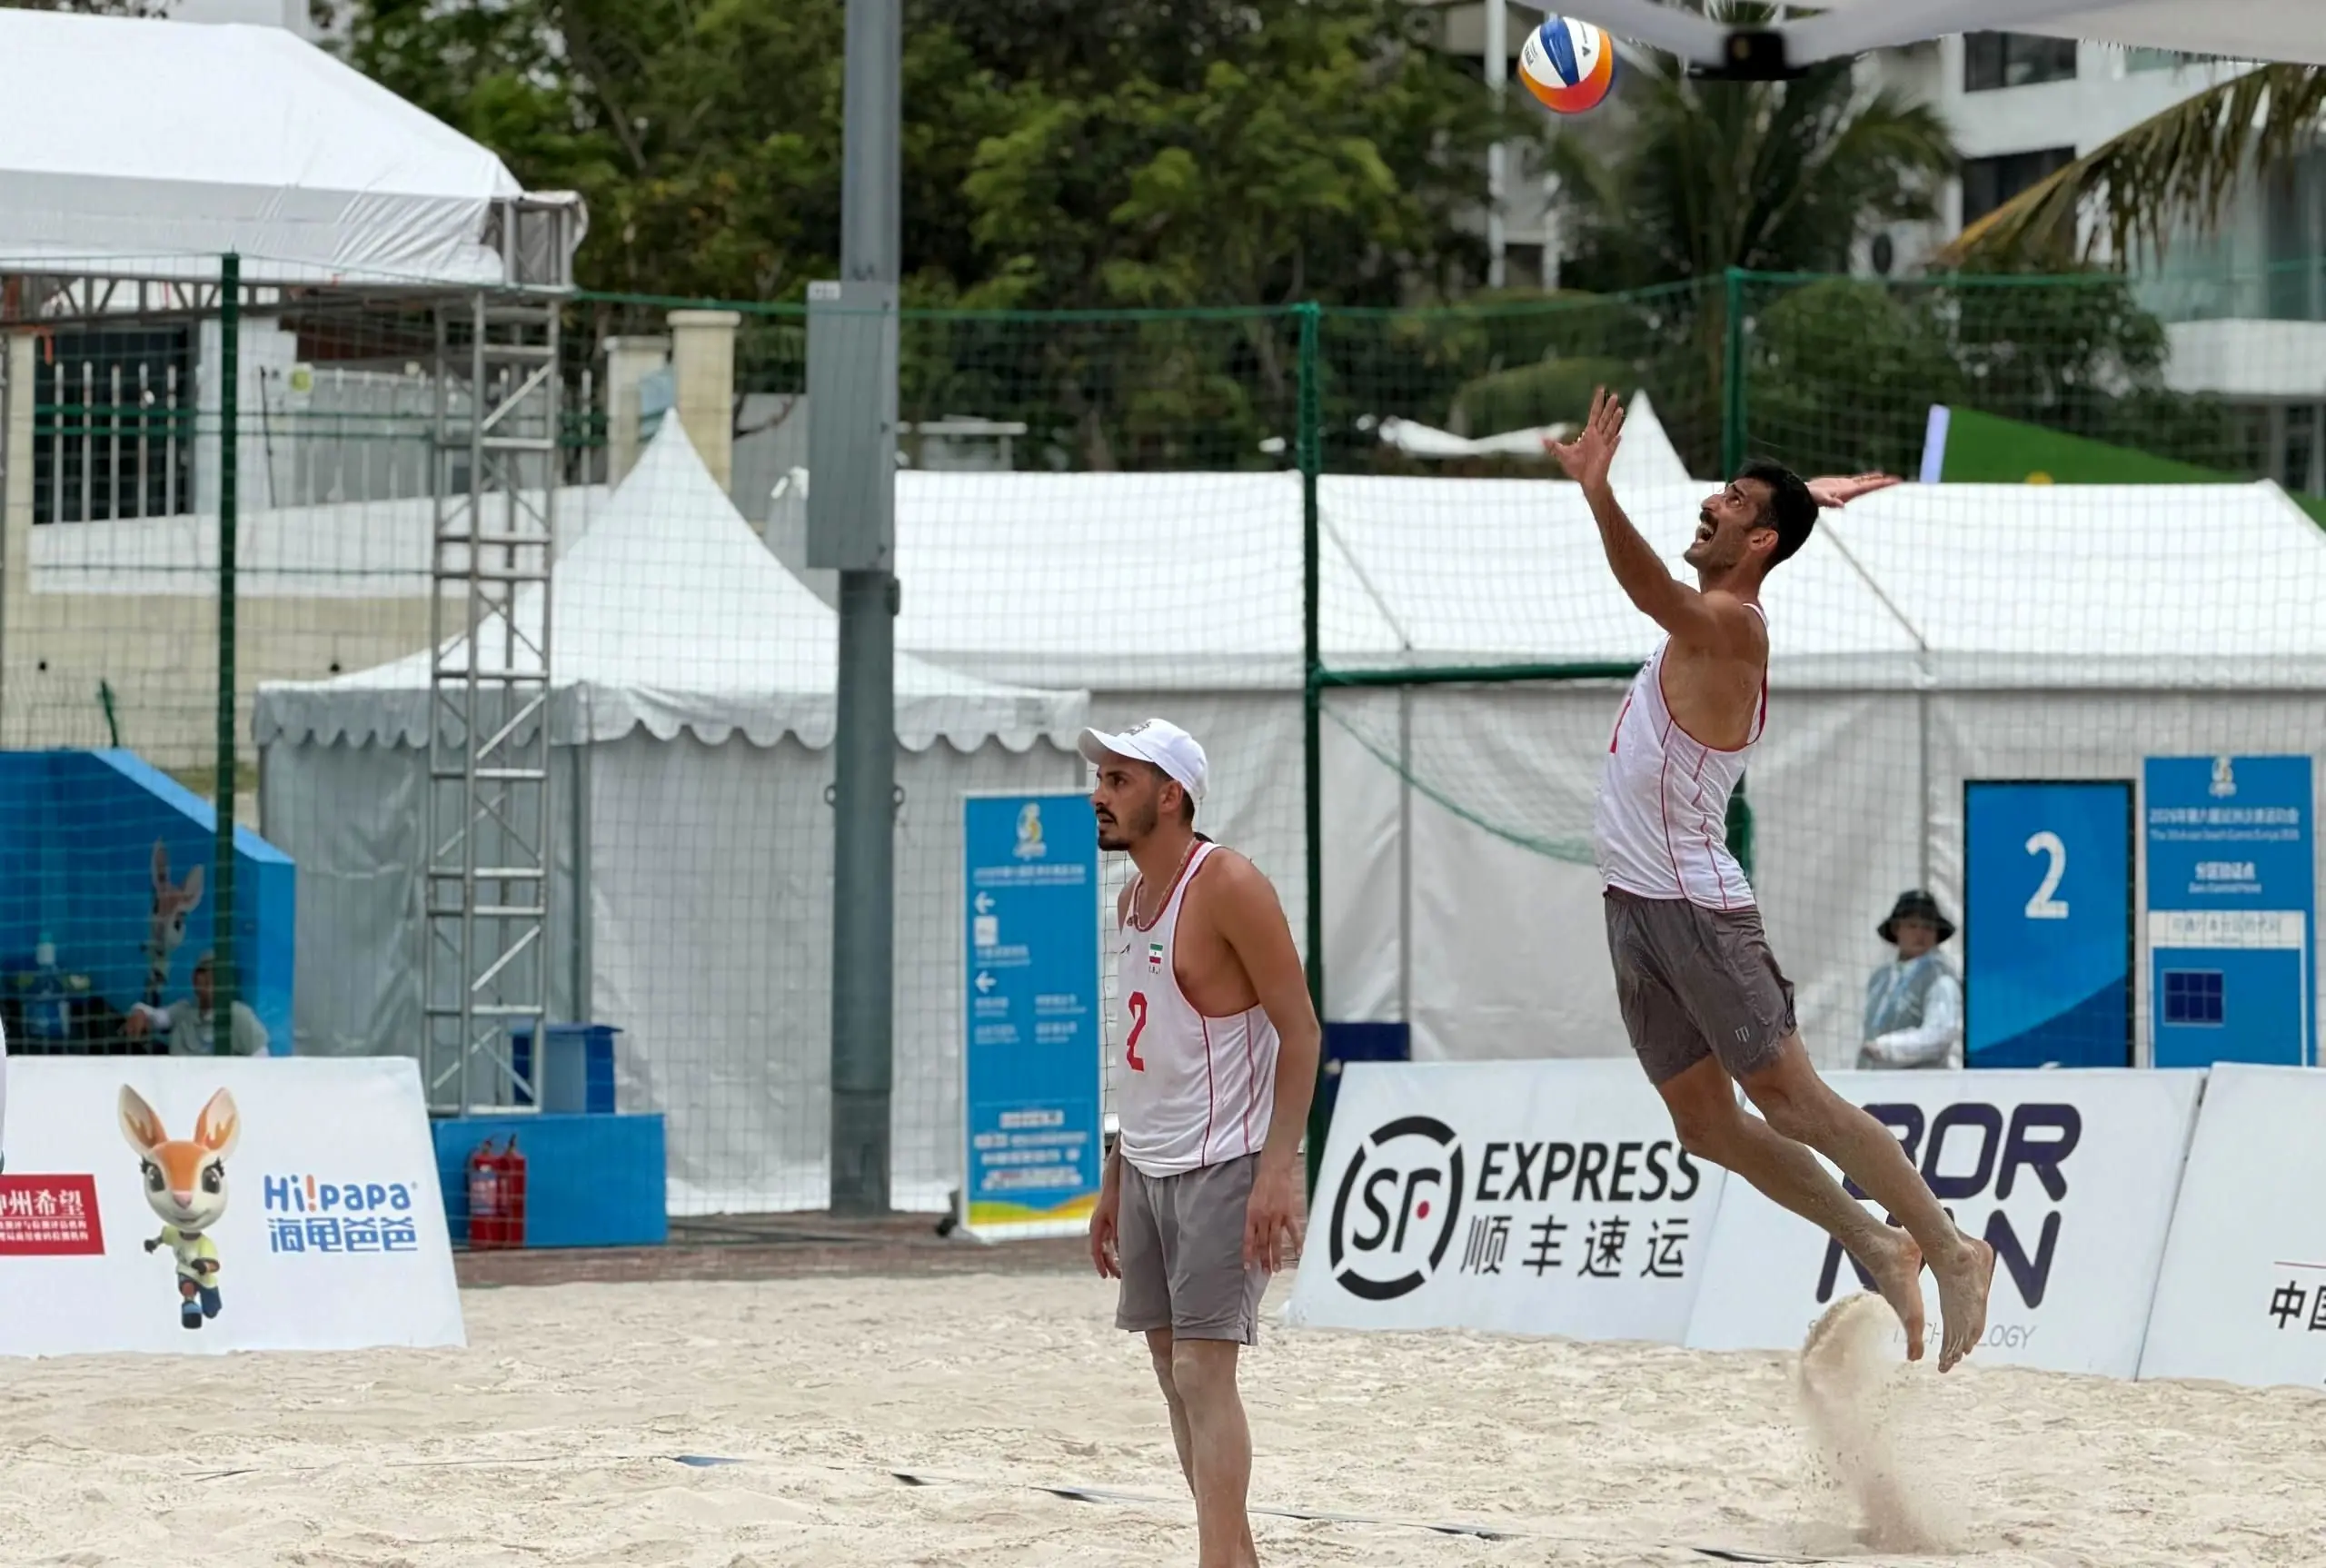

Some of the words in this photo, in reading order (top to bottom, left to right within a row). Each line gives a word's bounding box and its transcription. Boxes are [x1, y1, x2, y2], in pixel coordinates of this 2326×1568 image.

[2025, 830, 2069, 919] 2
[1126, 991, 1148, 1073] 2
[1475, 1140, 1700, 1202] EXPRESS
[267, 1216, 418, 1253] 海龟爸爸
[1460, 1215, 1690, 1277] 顺丰速运
